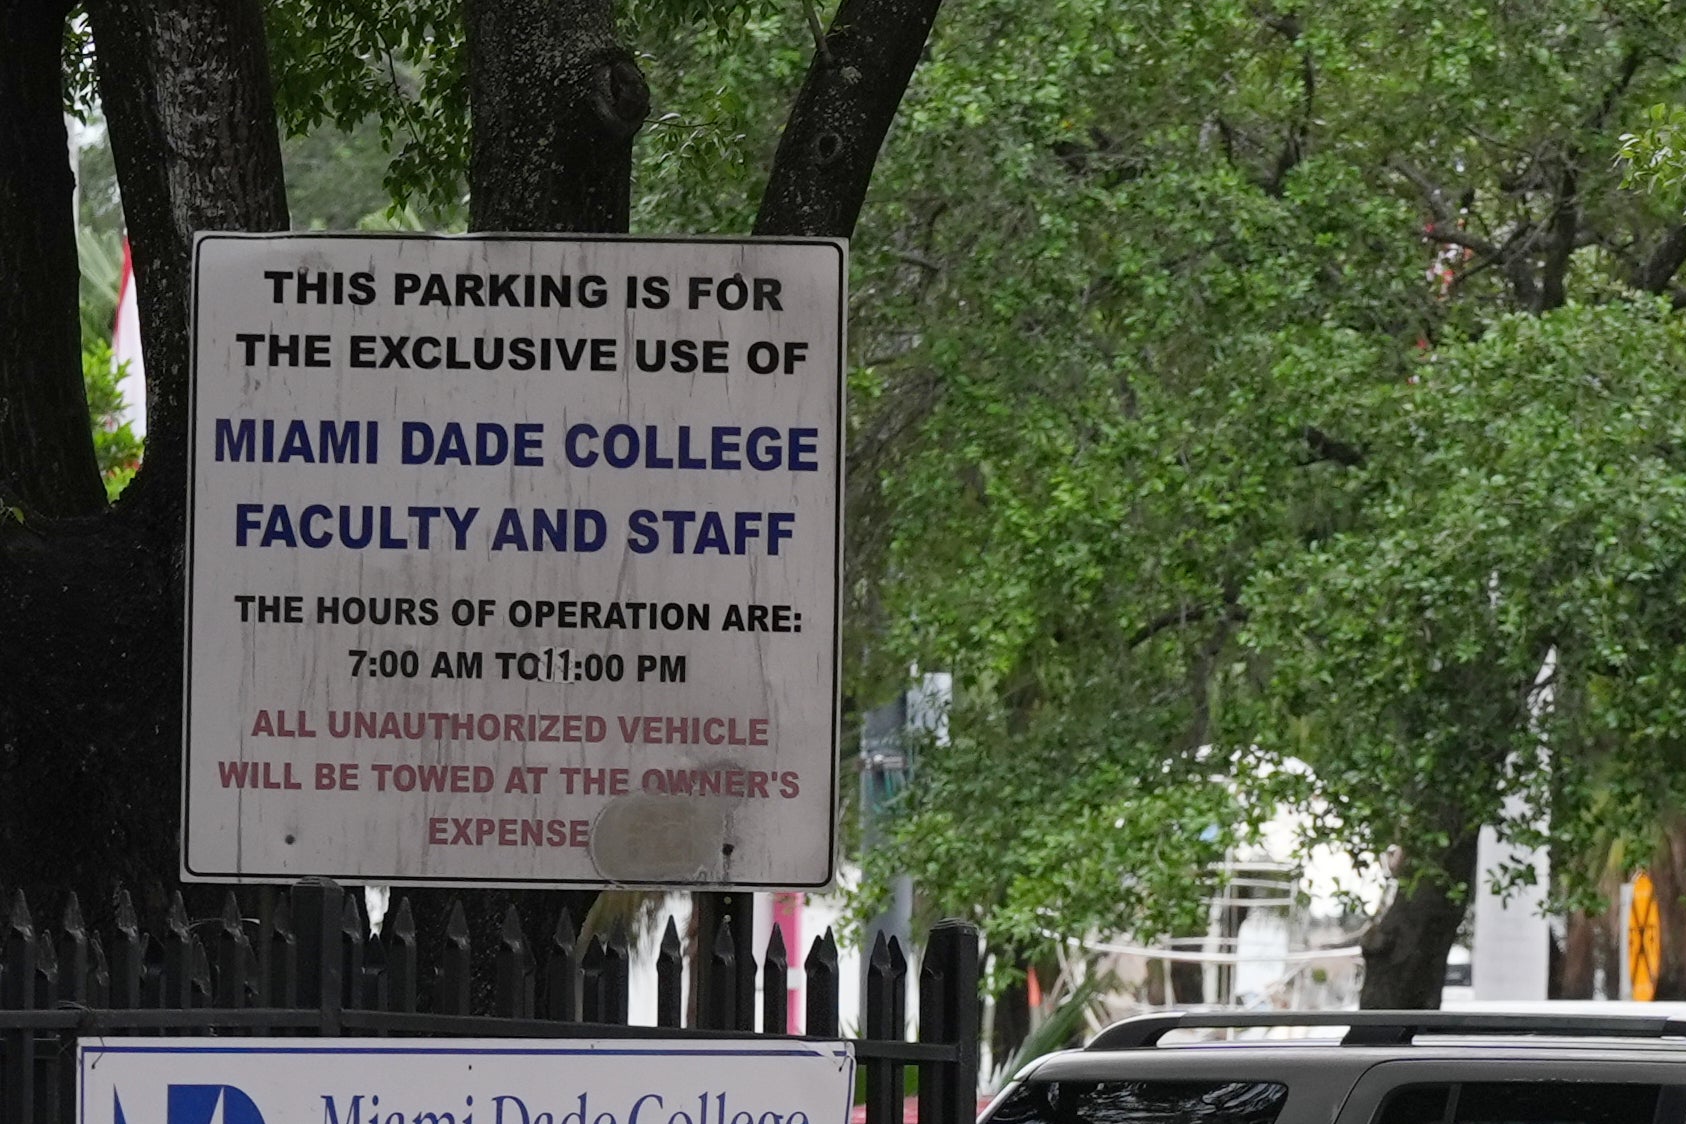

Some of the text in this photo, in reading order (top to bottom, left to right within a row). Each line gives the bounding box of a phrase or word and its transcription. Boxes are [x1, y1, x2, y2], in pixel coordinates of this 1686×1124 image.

[264, 270, 783, 311] THIS PARKING IS FOR
[236, 334, 808, 374] THE EXCLUSIVE USE OF
[215, 419, 818, 471] MIAMI DADE COLLEGE
[236, 504, 795, 555] FACULTY AND STAFF
[235, 596, 801, 632] THE HOURS OF OPERATION ARE:
[349, 650, 418, 678] 7:00
[431, 652, 482, 678] AM
[497, 652, 540, 681] TO
[638, 655, 685, 682] PM
[252, 710, 768, 745] ALL UNAUTHORIZED VEHICLE
[219, 762, 800, 799] WILL BE TOWED AT THE OWNER'S
[428, 817, 590, 848] EXPENSE
